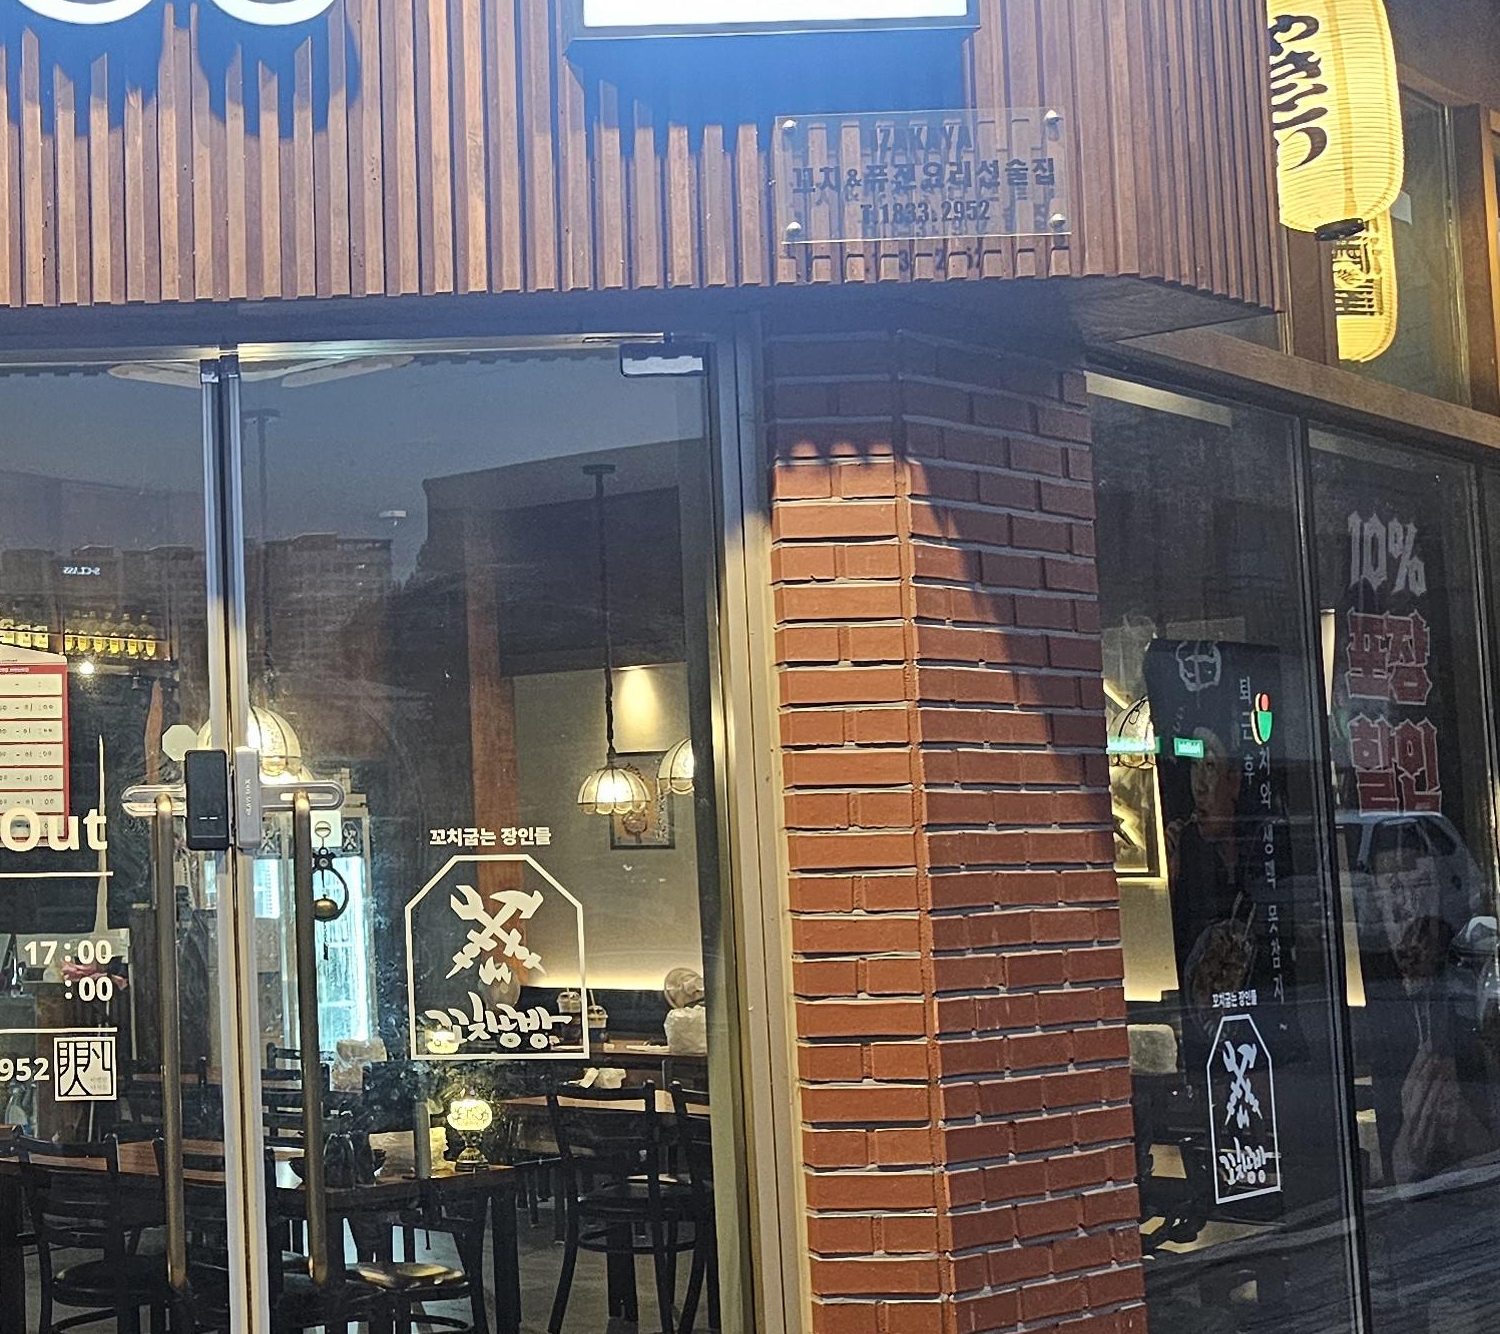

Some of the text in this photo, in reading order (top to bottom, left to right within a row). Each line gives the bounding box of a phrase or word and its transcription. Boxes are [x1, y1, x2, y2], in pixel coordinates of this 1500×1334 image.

[1347, 510, 1427, 598] 10%
[1345, 607, 1432, 706] 포장
[1347, 713, 1442, 816] 할인
[1, 805, 108, 852] Out
[430, 826, 552, 847] 꼬치굽는 장인들
[24, 940, 113, 965] 17:00
